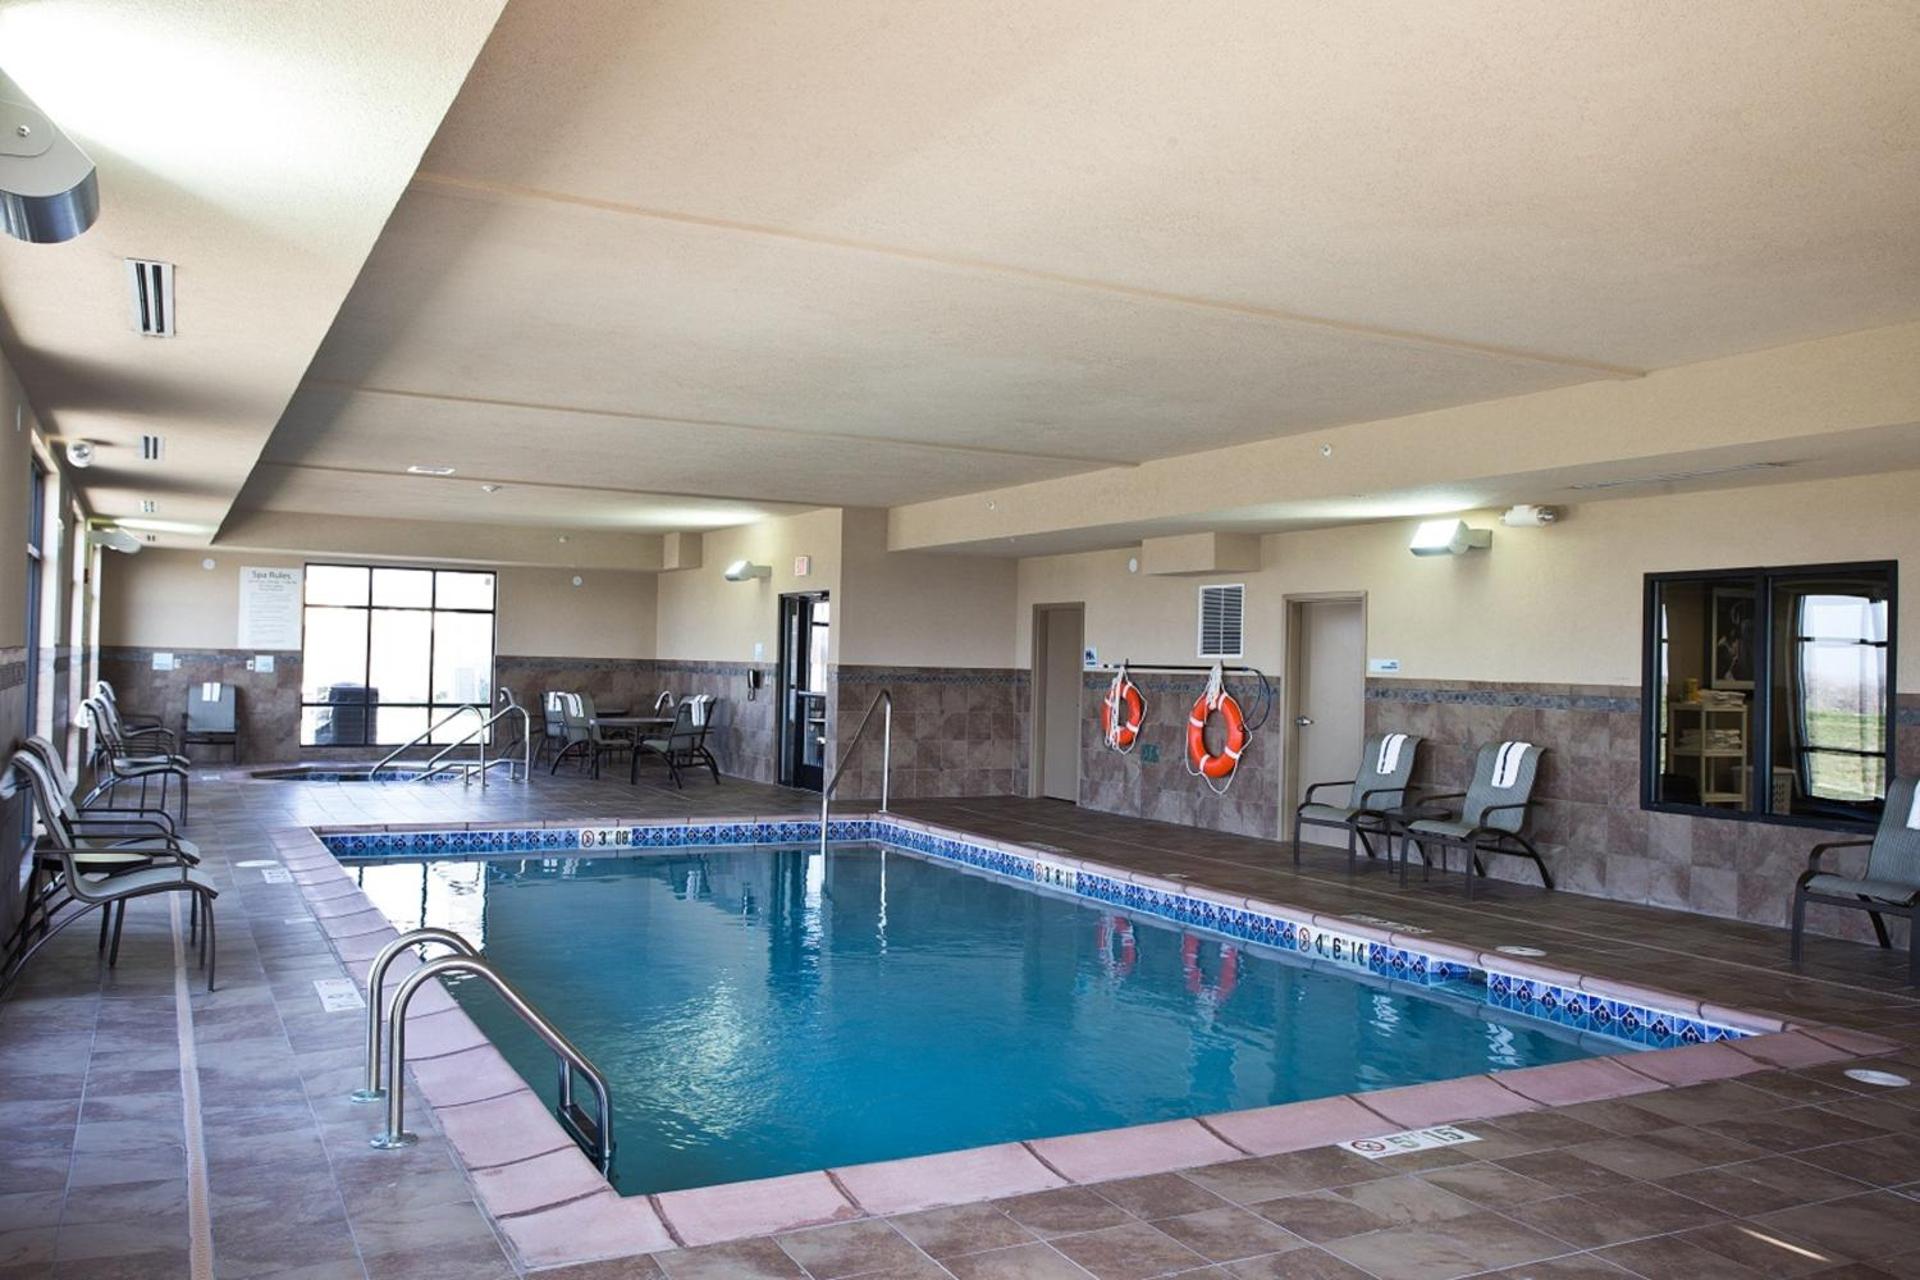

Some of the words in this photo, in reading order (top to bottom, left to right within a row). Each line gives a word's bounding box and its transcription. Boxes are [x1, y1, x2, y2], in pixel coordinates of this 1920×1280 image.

[251, 570, 267, 580] Spa
[269, 571, 292, 580] Rules
[598, 830, 607, 846] 3
[1315, 933, 1323, 954] 4
[1333, 937, 1341, 960] 6
